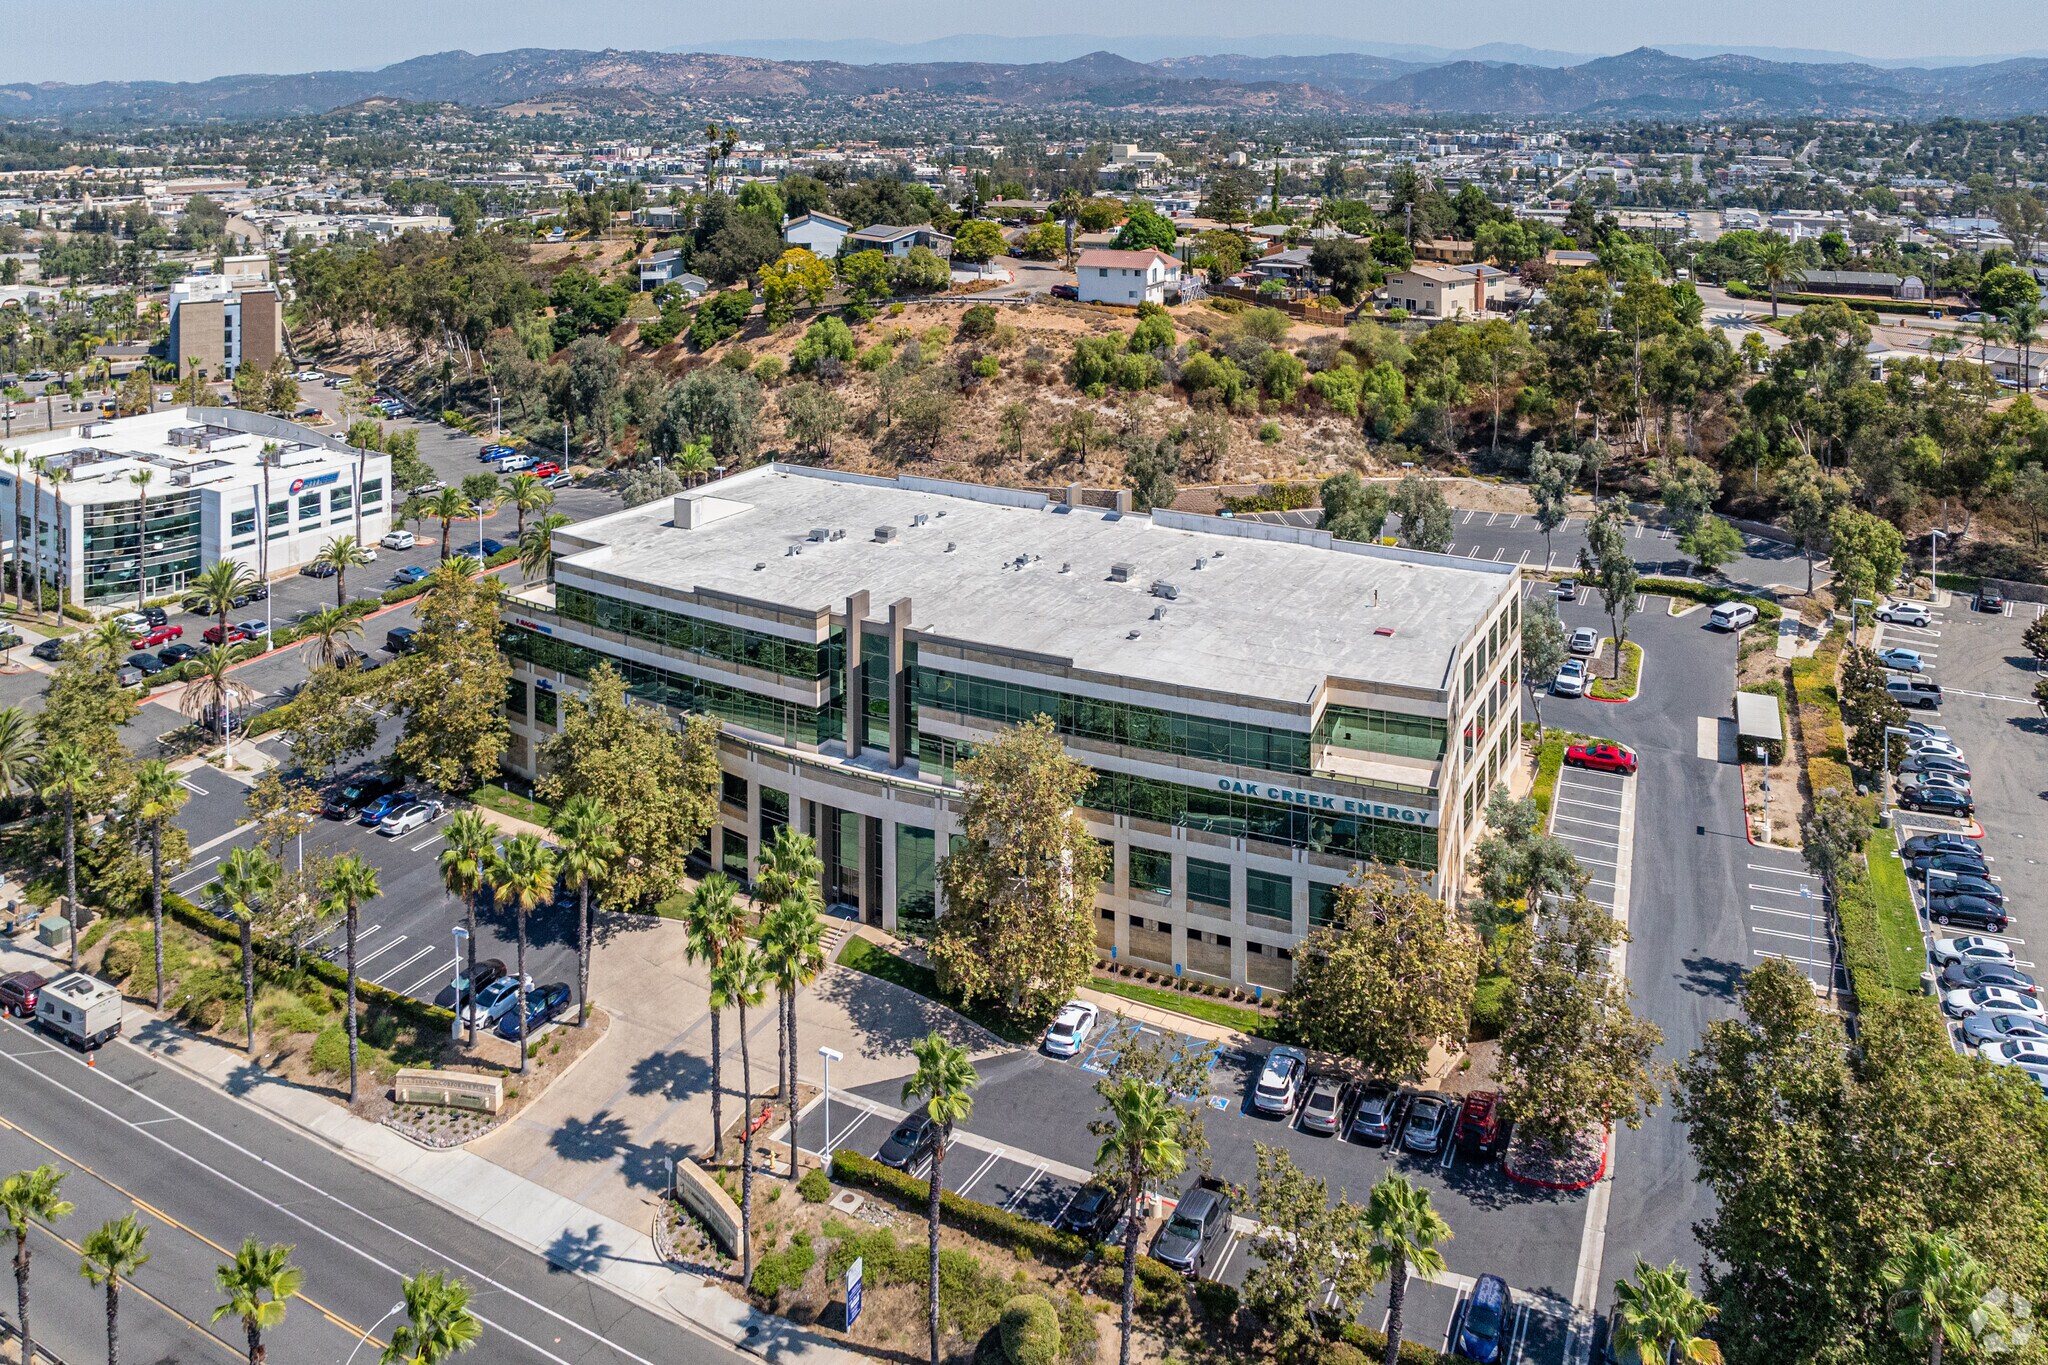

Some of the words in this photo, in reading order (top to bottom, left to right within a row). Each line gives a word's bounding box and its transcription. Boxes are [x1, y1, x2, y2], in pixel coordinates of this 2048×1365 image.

[1218, 778, 1260, 796] OAK
[1268, 787, 1336, 810] CREEK
[1344, 800, 1430, 824] ENERGY
[1082, 1063, 1109, 1074] PARKING
[411, 1078, 437, 1086] TERRAZA
[438, 1080, 472, 1090] CORPORATE
[473, 1084, 491, 1092] PLAZA
